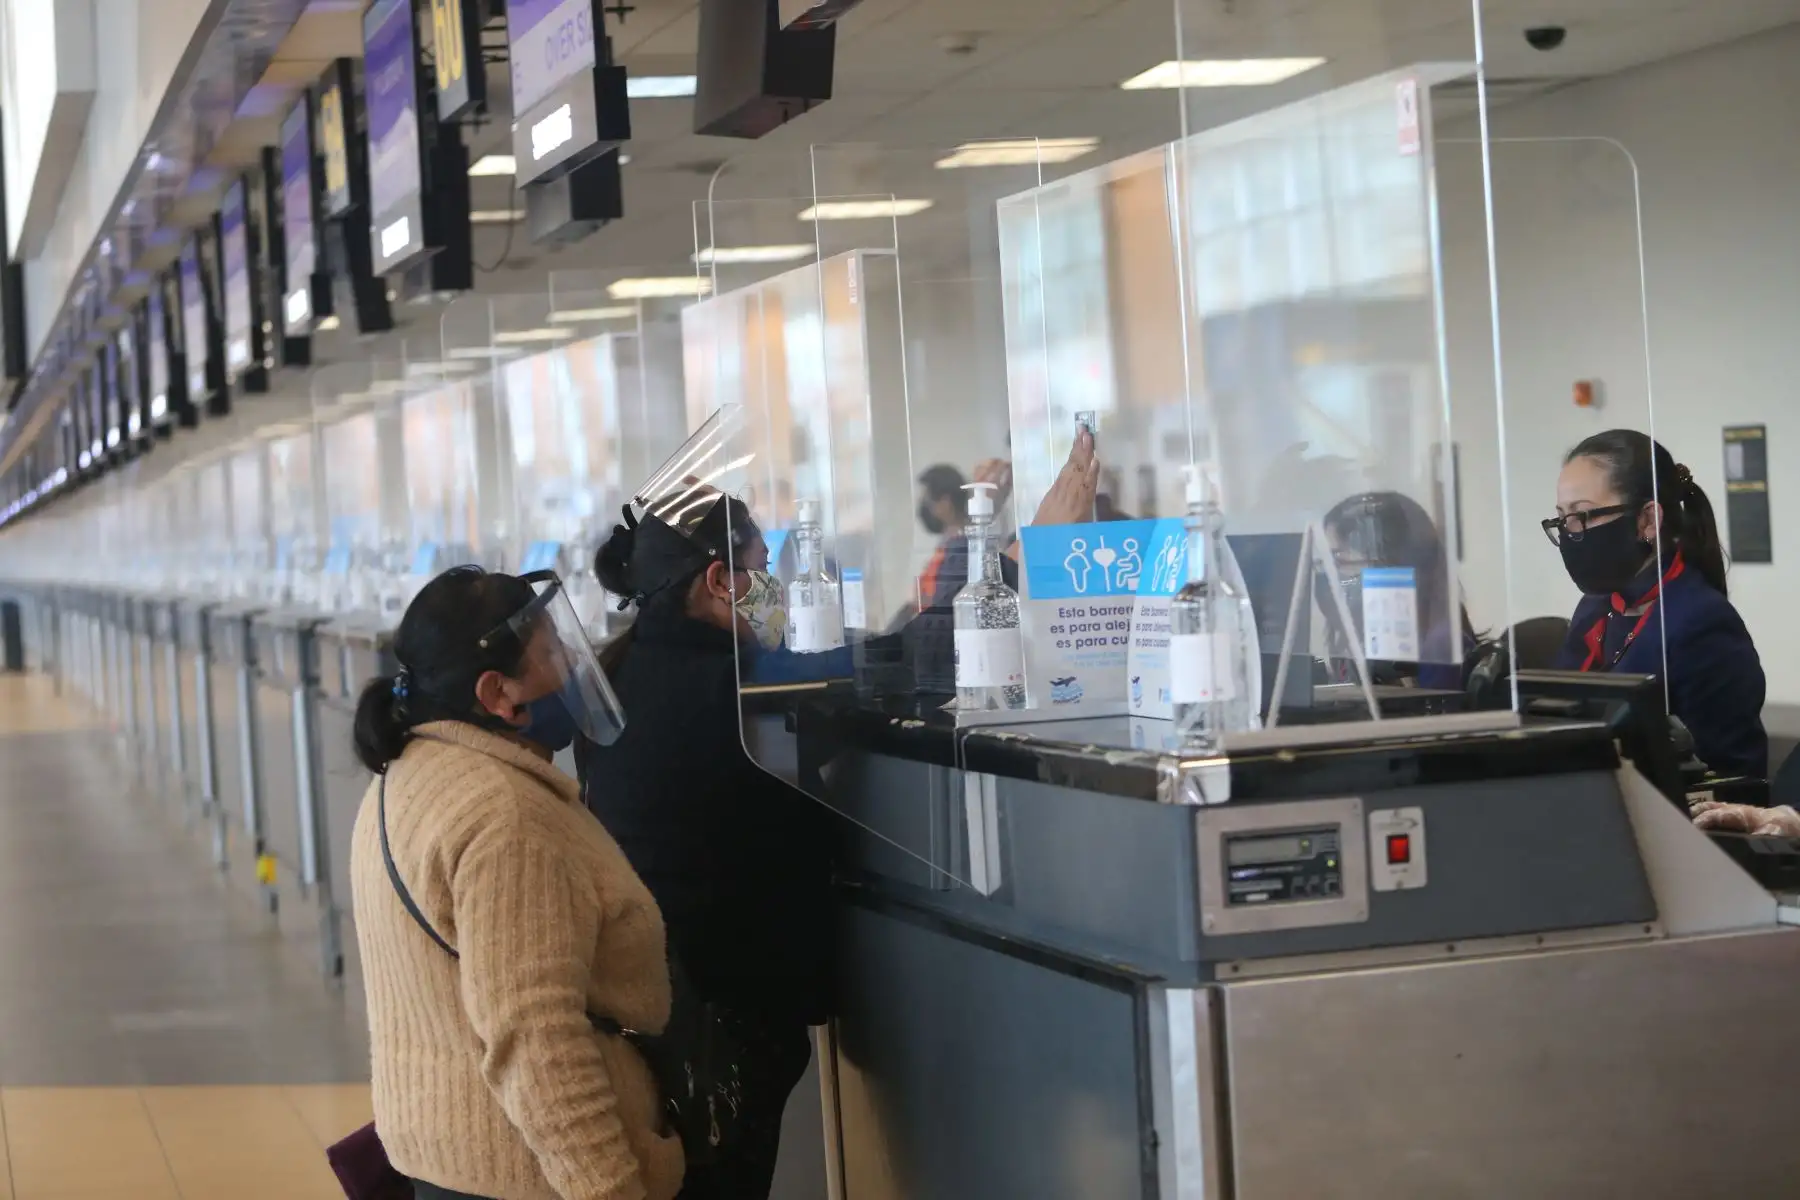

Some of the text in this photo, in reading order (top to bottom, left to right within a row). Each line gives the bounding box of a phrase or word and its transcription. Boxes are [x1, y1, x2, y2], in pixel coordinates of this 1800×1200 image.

[545, 19, 576, 71] OVER
[1058, 607, 1085, 619] Esta
[1050, 625, 1065, 634] es
[1069, 622, 1101, 635] para
[1056, 640, 1071, 649] es
[1075, 637, 1107, 650] para
